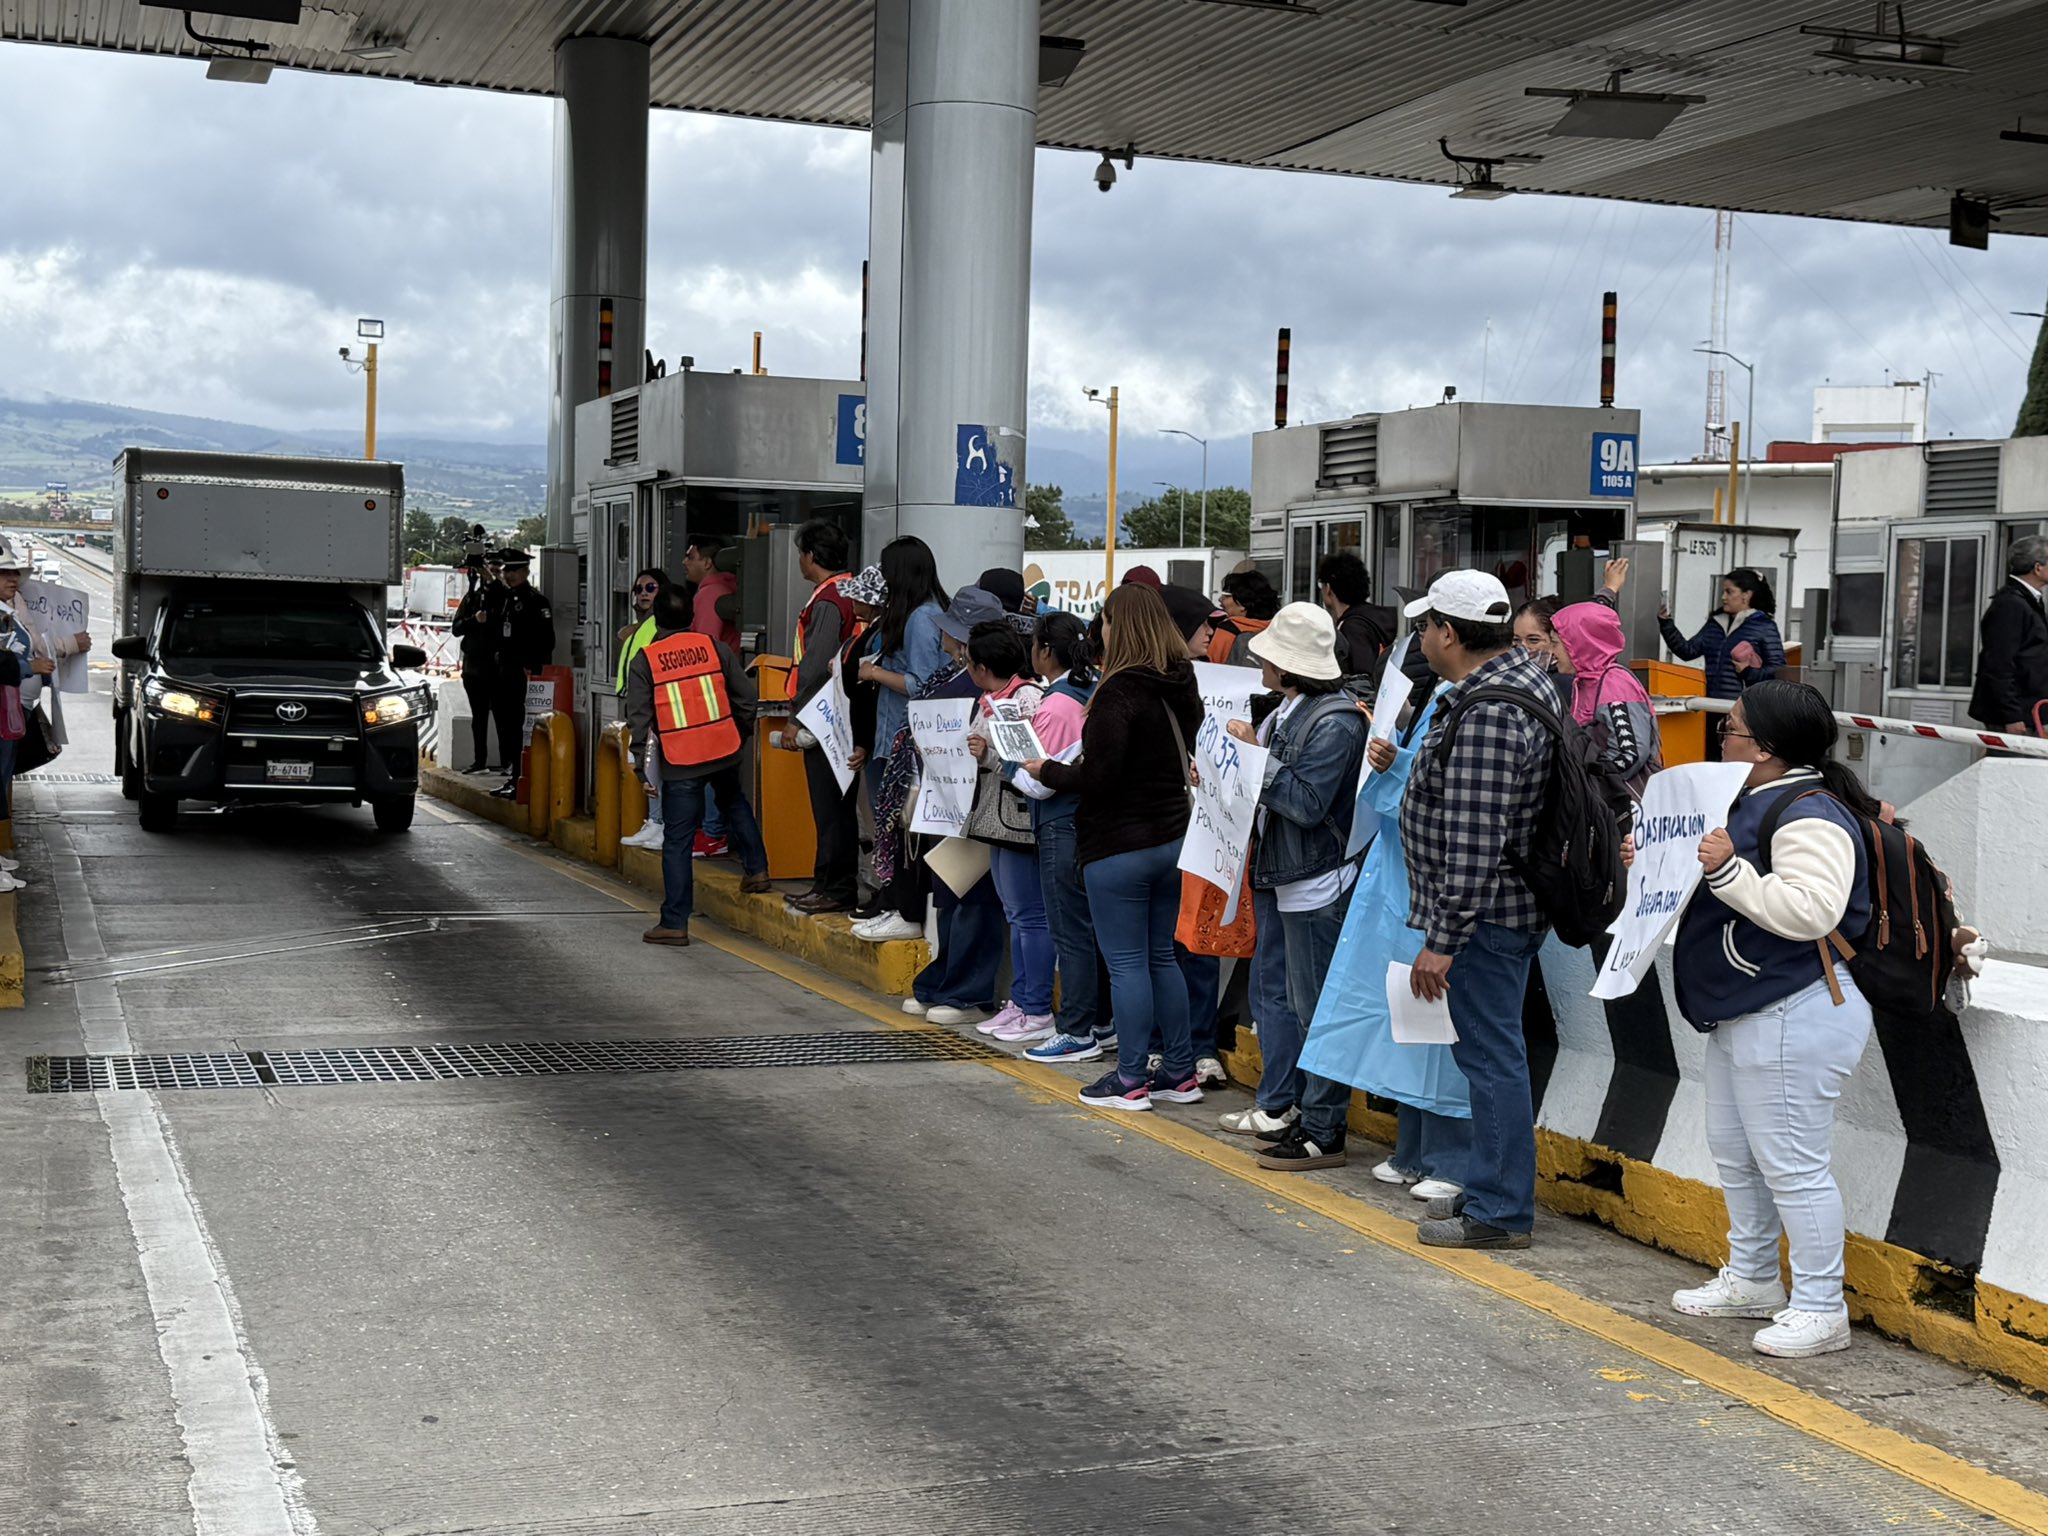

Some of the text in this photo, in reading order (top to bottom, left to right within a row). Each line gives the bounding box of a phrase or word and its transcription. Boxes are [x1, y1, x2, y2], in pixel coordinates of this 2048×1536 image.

[1600, 439, 1635, 472] 9A
[1602, 475, 1632, 488] 1105 A
[657, 646, 709, 672] SEGURIDAD
[1632, 800, 1706, 851] BASIFICACIÓN
